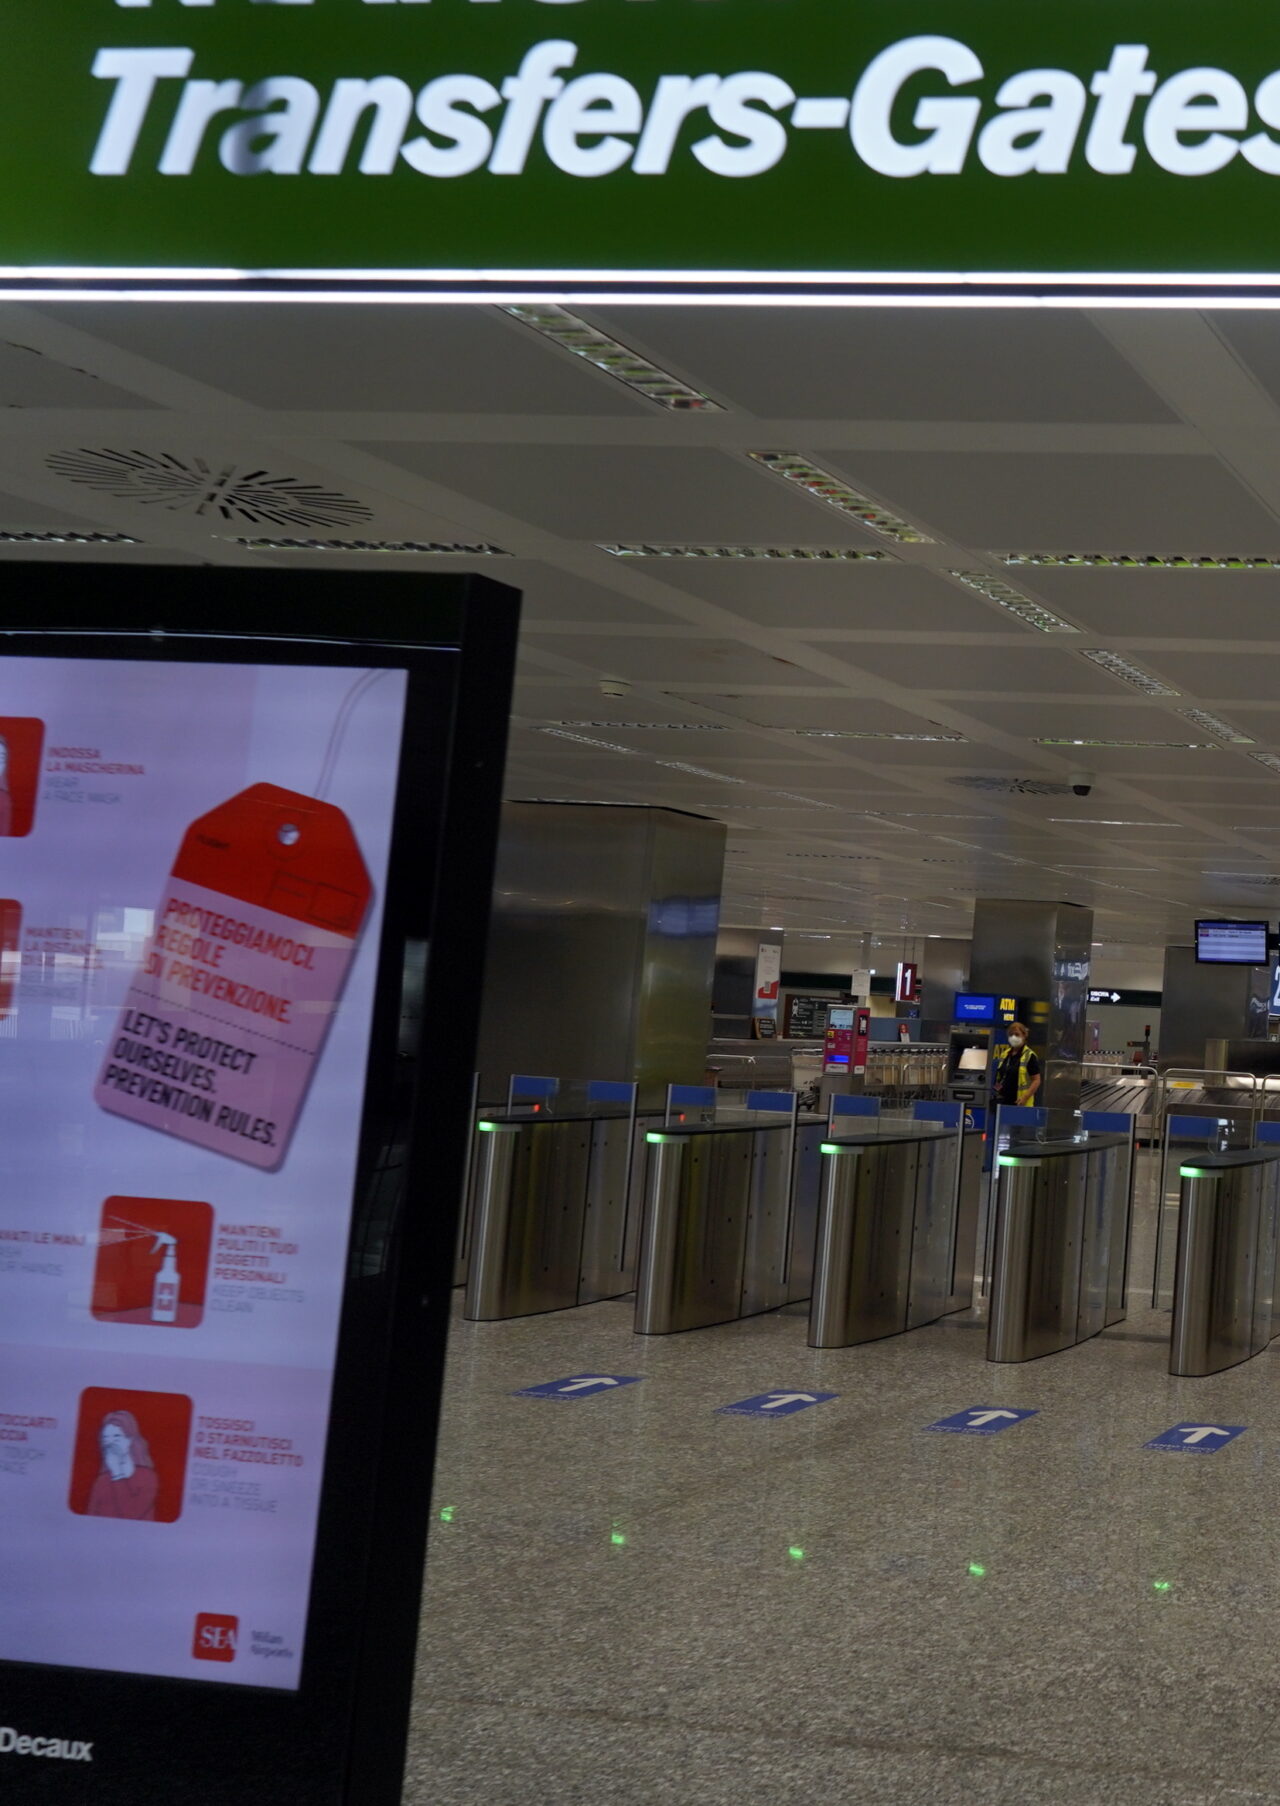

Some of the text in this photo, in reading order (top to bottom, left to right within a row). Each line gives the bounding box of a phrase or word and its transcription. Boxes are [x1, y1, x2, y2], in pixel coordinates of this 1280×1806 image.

[155, 924, 225, 969] REGOLE
[166, 897, 314, 971] PROTEGGIAMOCI.
[144, 956, 163, 977] DI
[168, 961, 292, 1024] PREVENZIONE.
[904, 969, 912, 996] 1
[1000, 998, 1015, 1011] ATM
[121, 1007, 256, 1075] LET'S PROTECT
[114, 1040, 217, 1094] OURSELVES.
[104, 1065, 277, 1148] PREVENTION RULES.
[214, 1267, 286, 1284] PERSONALI
[223, 1448, 304, 1467] FAZZOLETTO
[0, 1726, 94, 1762] Decaux
